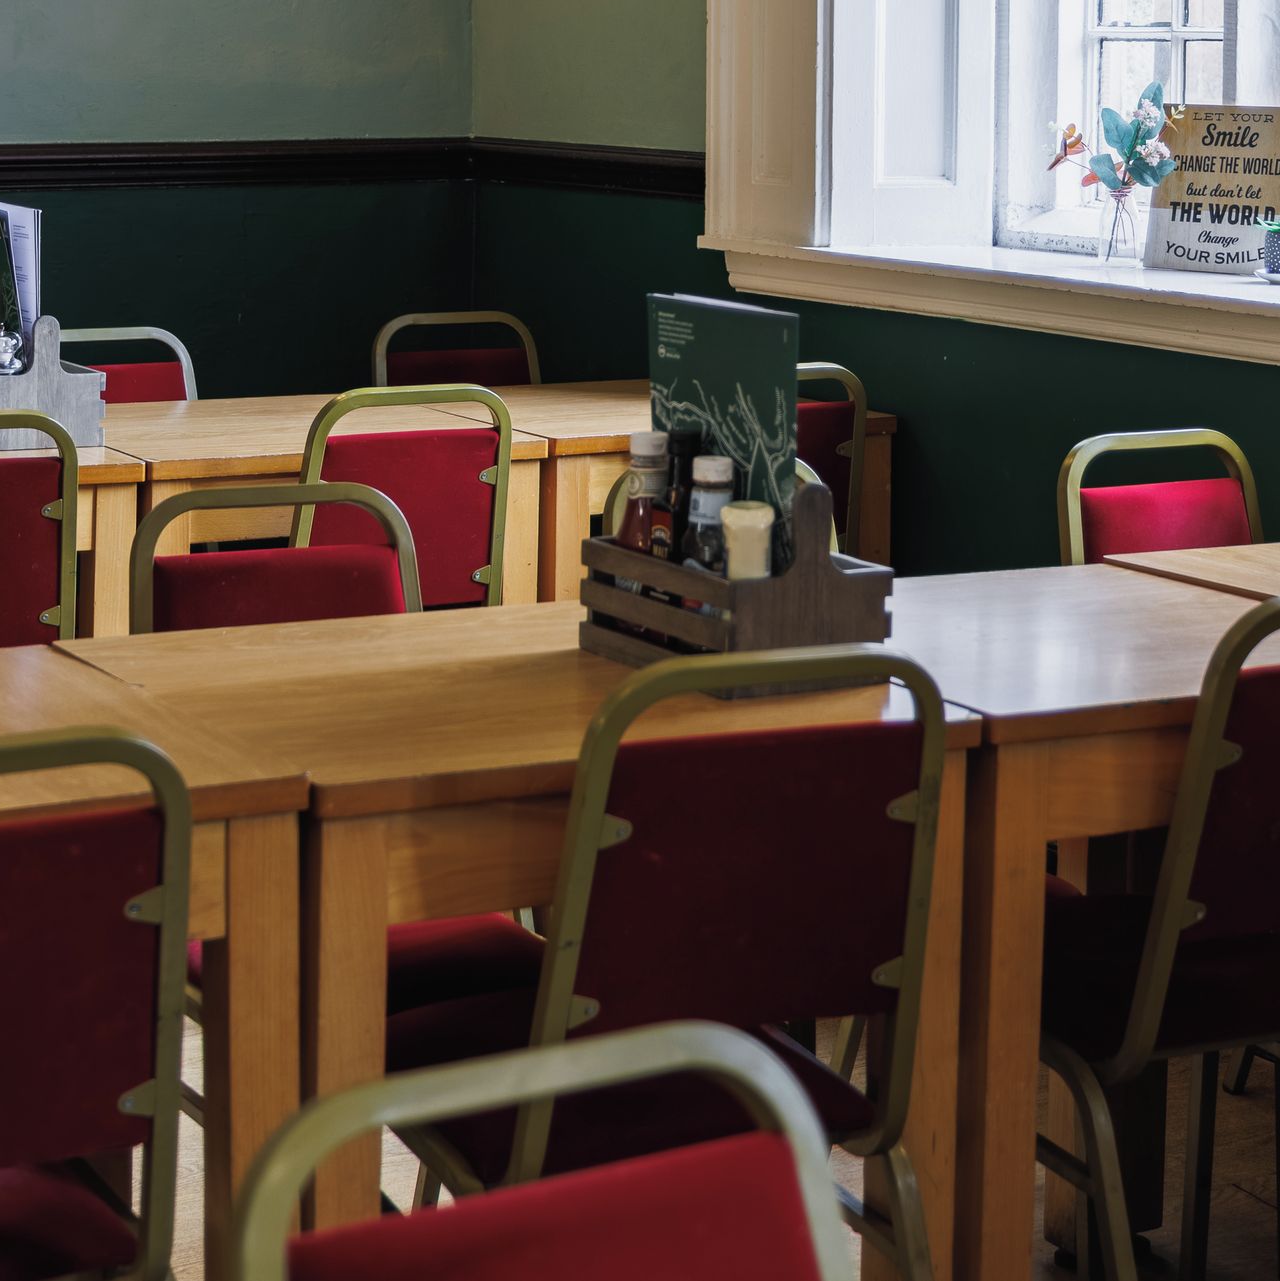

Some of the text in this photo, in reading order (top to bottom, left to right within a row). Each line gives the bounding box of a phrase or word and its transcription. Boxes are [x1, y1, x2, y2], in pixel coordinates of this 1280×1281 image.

[1193, 112, 1274, 123] LET YOUR
[1201, 123, 1259, 148] Smile
[1173, 154, 1216, 173] CHANGE
[1220, 156, 1239, 174] THE
[1186, 182, 1262, 200] but don't let
[1169, 201, 1276, 226] THE WORLD
[1197, 230, 1239, 248] Change
[1166, 241, 1265, 265] YOUR SMILE
